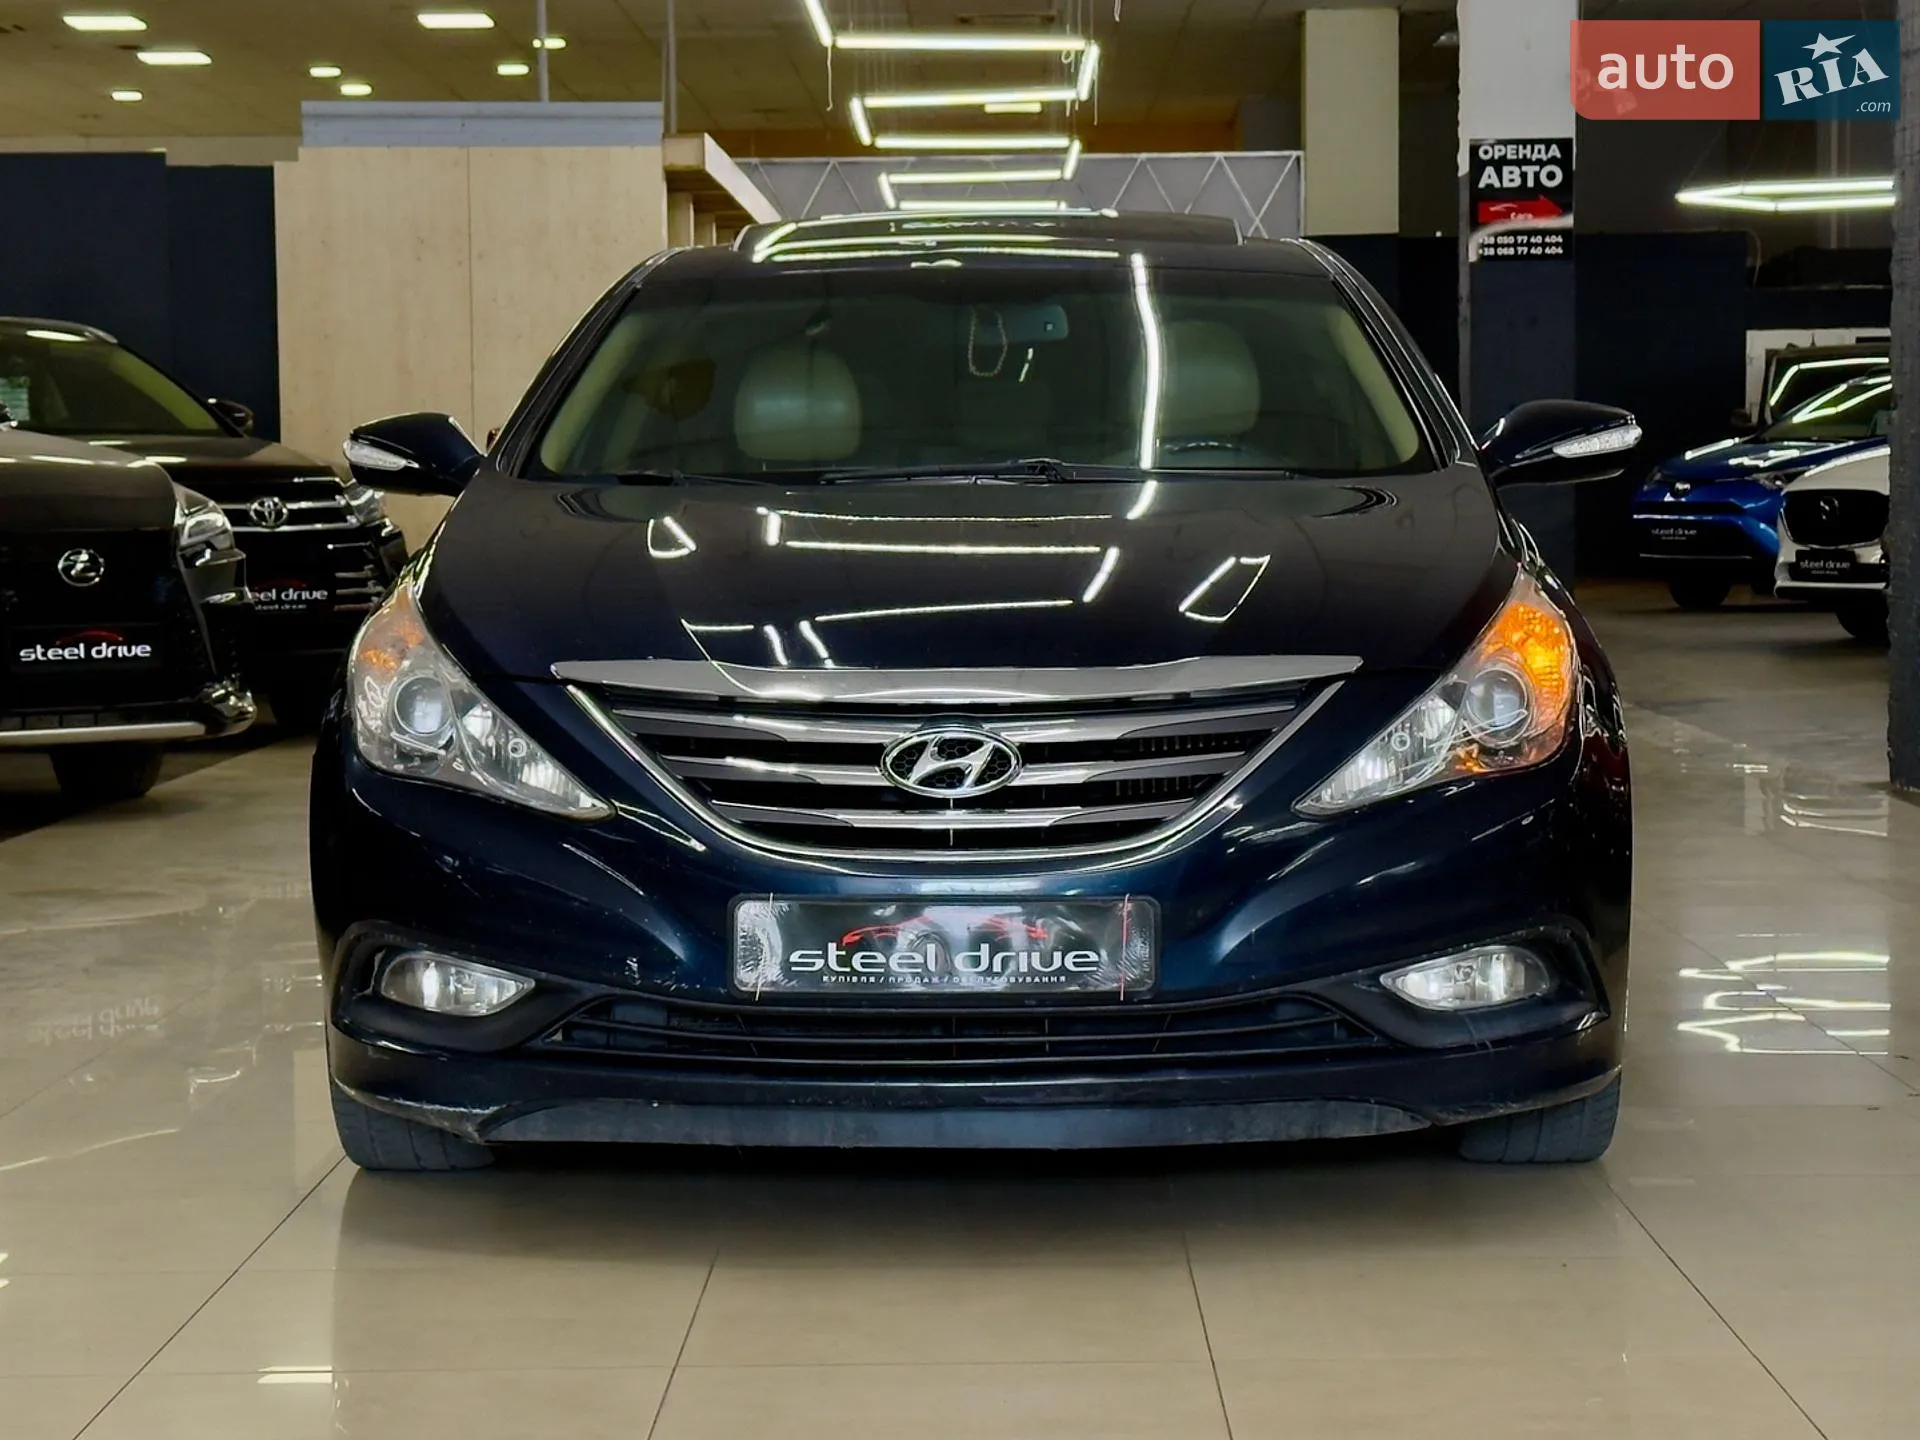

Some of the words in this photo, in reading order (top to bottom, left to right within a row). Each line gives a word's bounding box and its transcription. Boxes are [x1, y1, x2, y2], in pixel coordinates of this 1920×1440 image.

[1478, 144, 1561, 161] ОРЕНДА
[1478, 164, 1563, 188] АВТО
[250, 588, 276, 602] eel
[281, 588, 328, 601] drive
[19, 642, 85, 661] steel
[90, 642, 152, 659] drive
[789, 942, 936, 972] steel
[954, 943, 1100, 972] drive
[953, 975, 1066, 983] ОЛУГОВУВАННЯ
